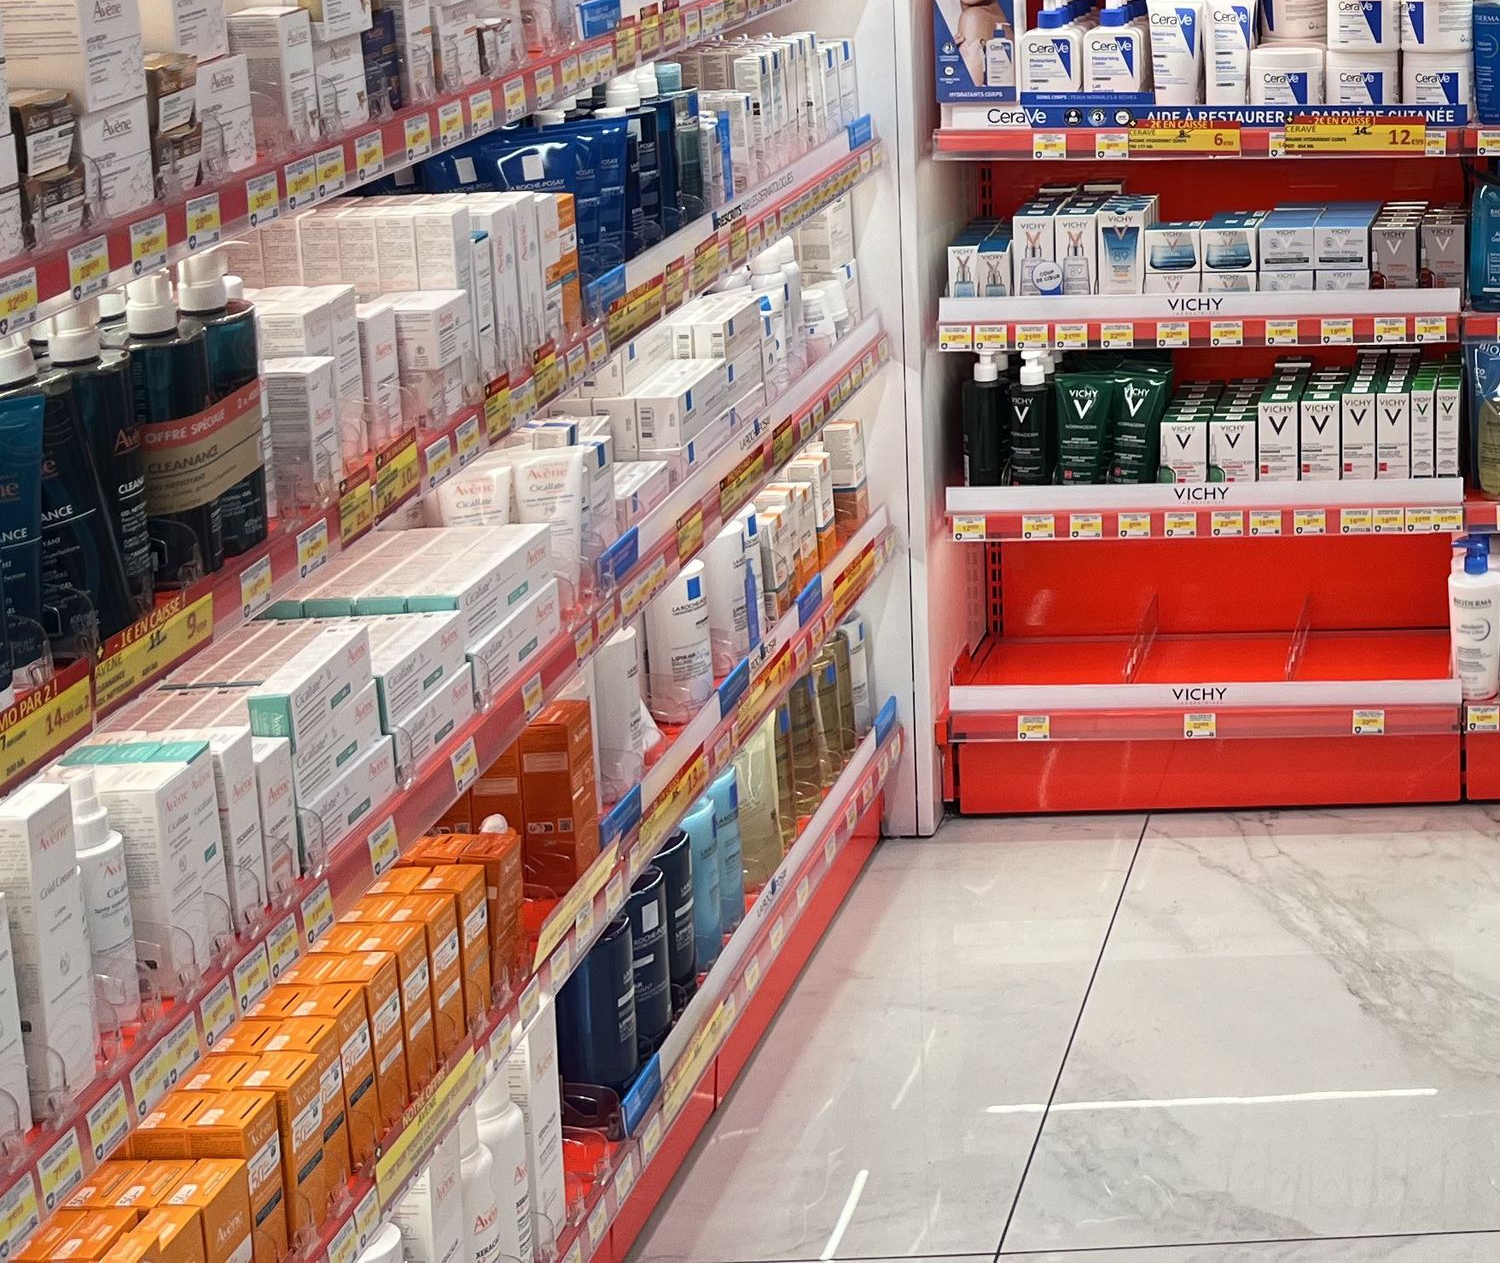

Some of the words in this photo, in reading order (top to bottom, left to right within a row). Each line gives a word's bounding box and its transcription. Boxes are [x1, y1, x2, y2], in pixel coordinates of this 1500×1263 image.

[93, 0, 122, 19] Avène
[987, 108, 1046, 125] CeraVe
[1343, 117, 1372, 125] CAISSE
[102, 117, 133, 137] Avène
[1151, 120, 1161, 129] 2€
[1163, 121, 1176, 129] EN
[1178, 120, 1208, 128] CAISSE
[1285, 125, 1316, 133] CERAVE
[1039, 270, 1055, 280] COUP
[1167, 297, 1224, 312] VICHY
[1069, 390, 1098, 399] VICHY
[1125, 388, 1150, 398] VICHY
[1012, 397, 1033, 405] VICHY
[1263, 405, 1293, 414] VICHY
[144, 428, 187, 444] OFFRE
[191, 409, 225, 436] SPÉCIALE
[1221, 425, 1245, 433] VICHY
[528, 467, 567, 480] Avène
[454, 480, 494, 497] Avène
[1174, 487, 1229, 502] VICHY
[1454, 597, 1492, 607] BIODERMA
[121, 630, 132, 648] 1€
[134, 620, 150, 639] EN
[150, 597, 180, 629] CAISSE
[97, 656, 123, 677] AVENE
[1172, 688, 1227, 701] VICHY
[19, 693, 42, 718] PAR
[39, 824, 70, 852] Avène
